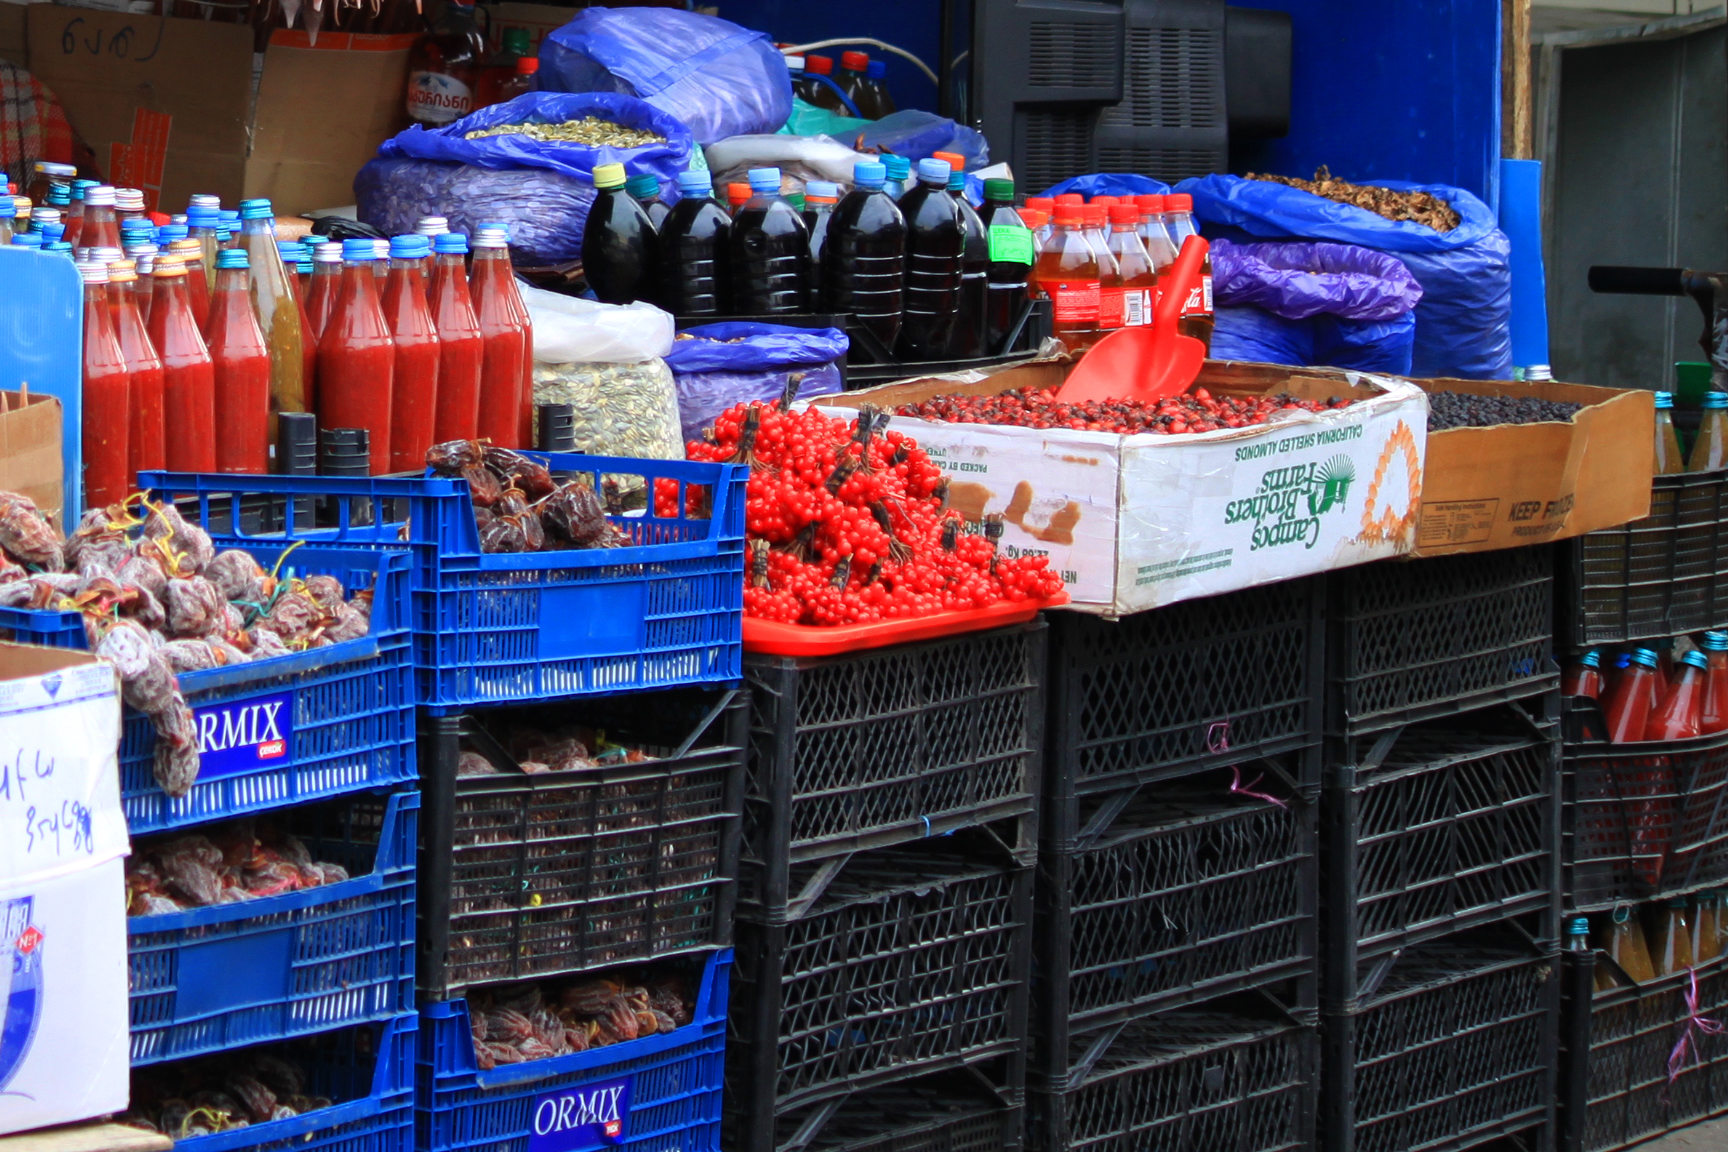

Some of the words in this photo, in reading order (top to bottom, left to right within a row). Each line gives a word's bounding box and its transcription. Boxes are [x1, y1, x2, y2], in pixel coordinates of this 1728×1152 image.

[1317, 424, 1363, 442] CALIFORNIA
[1235, 444, 1278, 462] ALMONDS
[1250, 516, 1320, 551] Campos
[191, 701, 283, 754] RMIX
[534, 1084, 625, 1136] ORMIX
